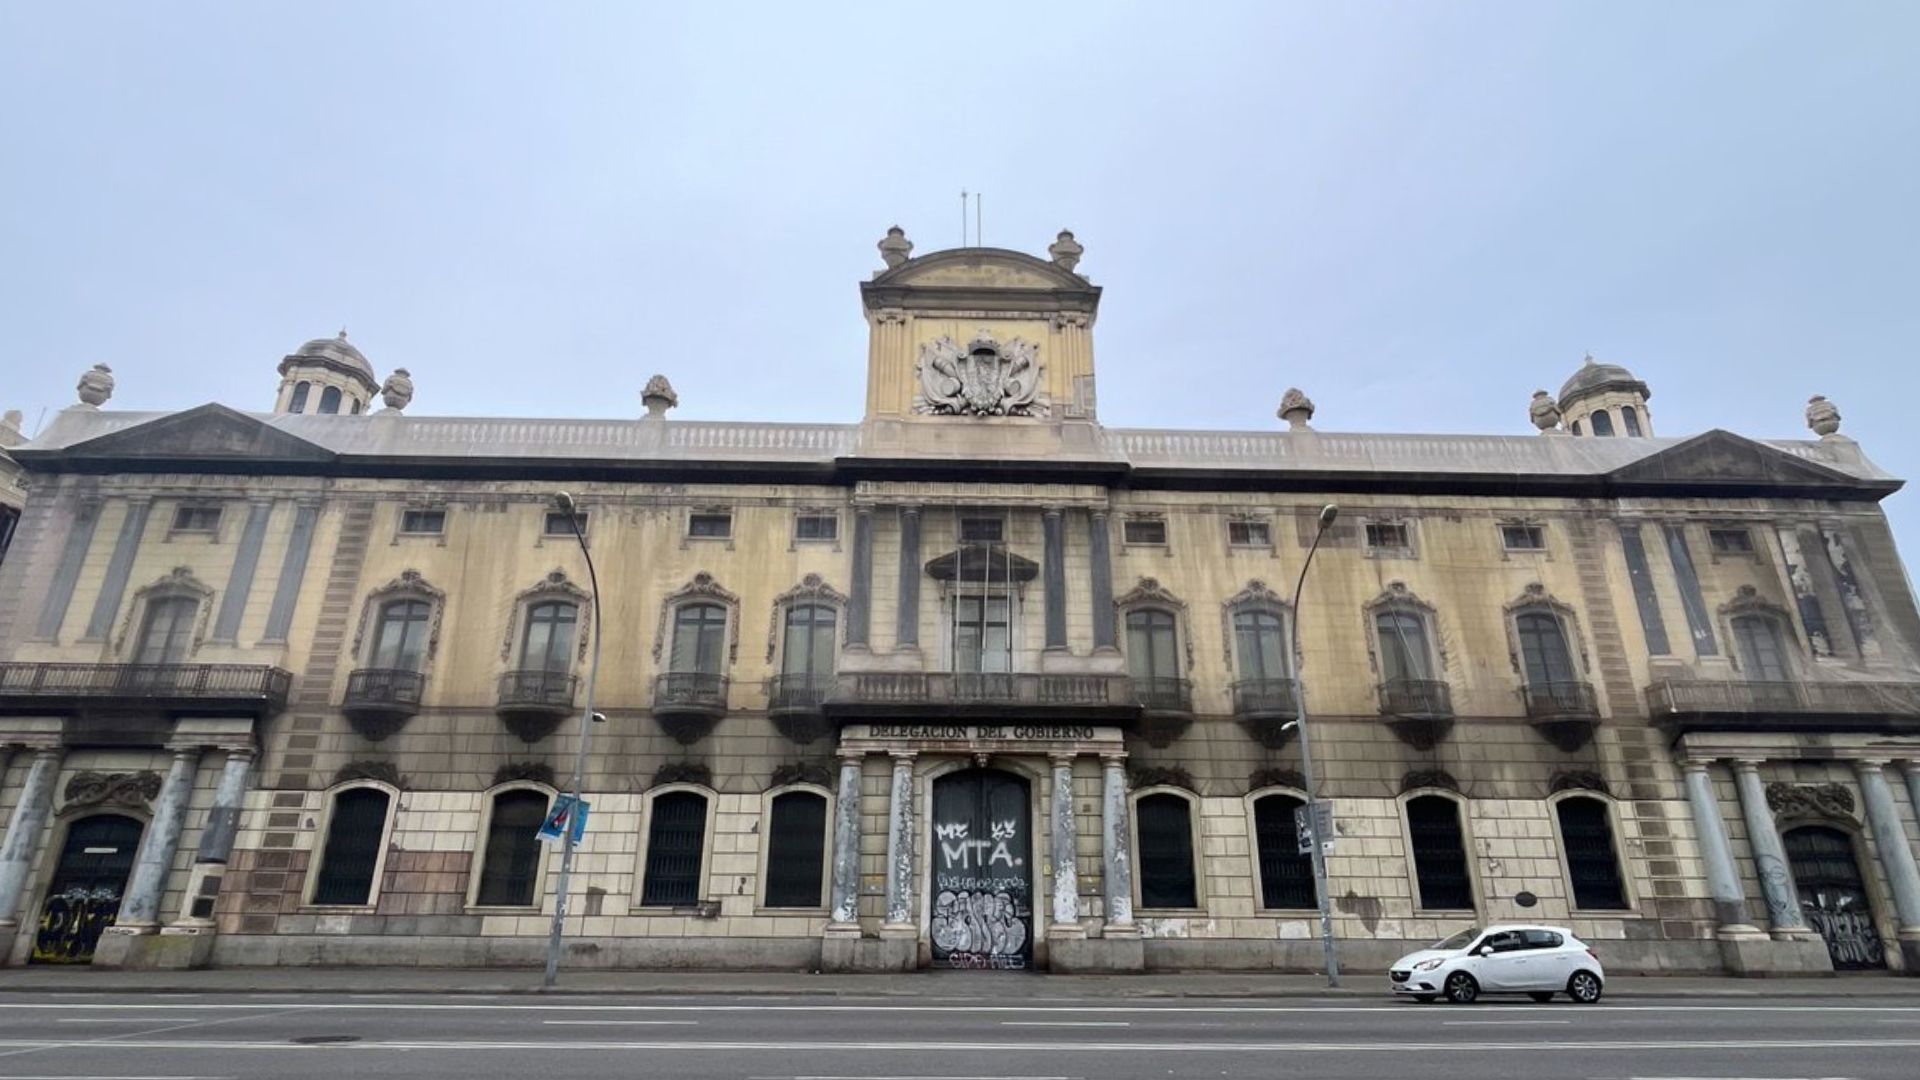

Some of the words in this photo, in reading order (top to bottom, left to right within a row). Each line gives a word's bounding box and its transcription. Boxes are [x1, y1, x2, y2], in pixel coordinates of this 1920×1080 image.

[869, 725, 967, 738] DELEGACION
[976, 725, 1007, 738] DEL
[1014, 725, 1094, 739] GOBIERNO
